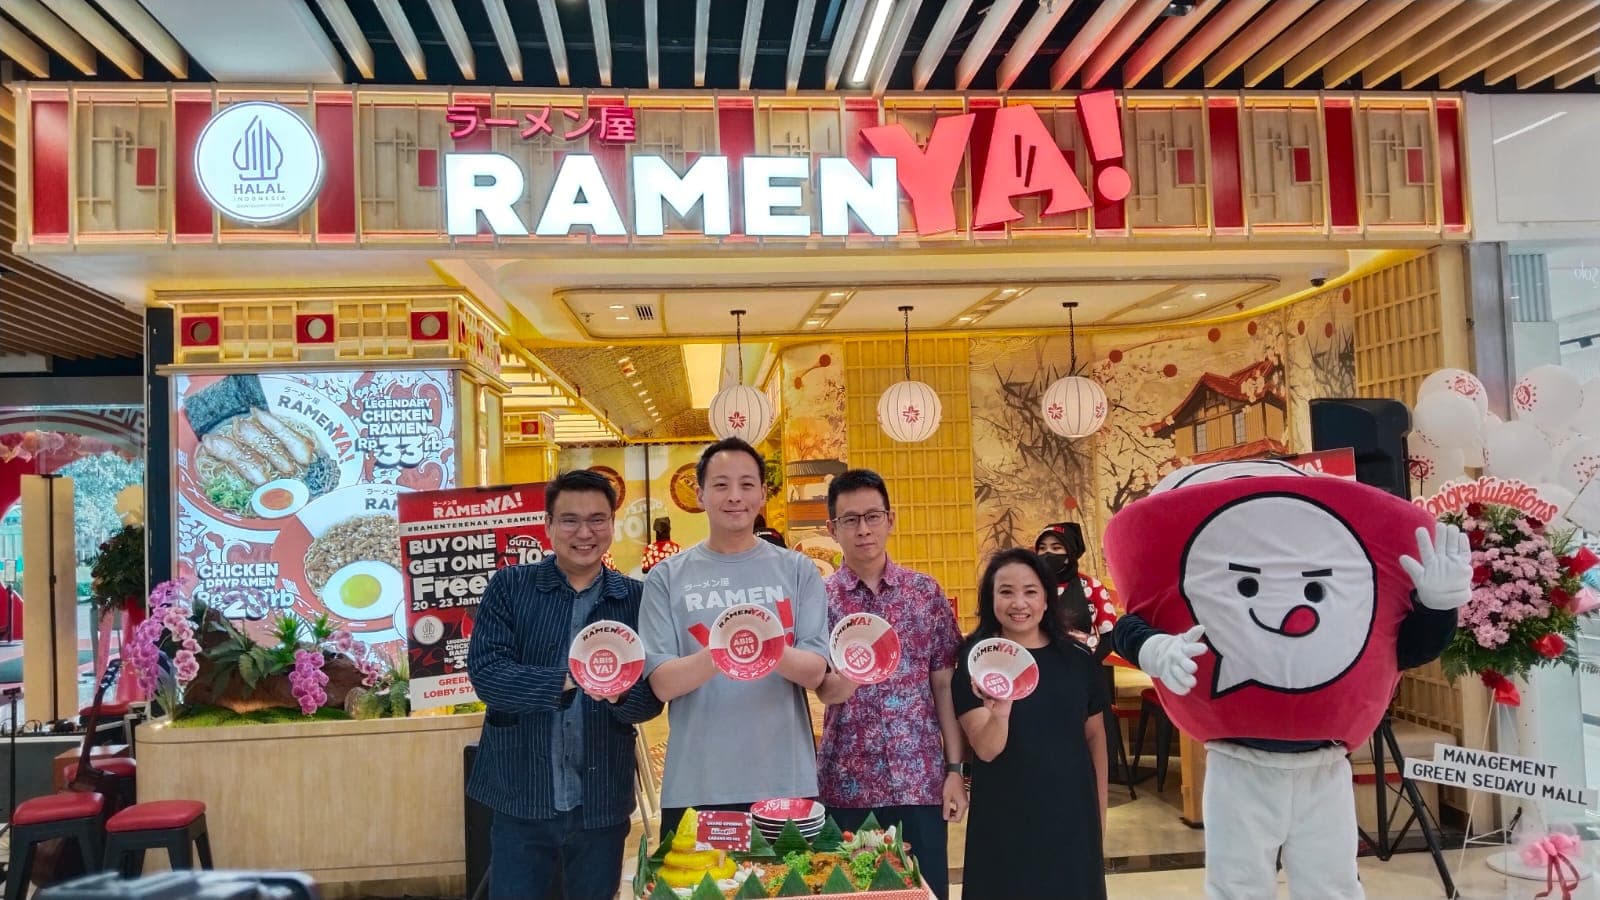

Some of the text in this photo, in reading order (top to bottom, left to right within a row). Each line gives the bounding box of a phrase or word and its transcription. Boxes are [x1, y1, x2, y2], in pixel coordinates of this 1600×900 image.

[446, 106, 637, 143] ラーメン屋
[233, 183, 285, 194] HALAL
[365, 399, 431, 409] LEGENDARY
[362, 408, 433, 423] CHICKEN
[369, 422, 428, 437] RAMEN
[366, 488, 398, 496] ラーメン
[507, 515, 545, 523] RAMENY
[408, 533, 496, 555] BUY ONE
[509, 539, 541, 548] OUTLET
[199, 563, 279, 578] CHICKEN
[408, 553, 496, 575] GET ONE
[684, 578, 730, 591] ラーメン屋
[413, 600, 429, 611] 20
[440, 598, 453, 608] 23
[685, 586, 784, 612] RAMEN
[734, 636, 754, 646] ABIS
[735, 645, 755, 655] YA!
[595, 664, 613, 674] YA!
[424, 690, 456, 699] LOBBY
[1443, 748, 1557, 779] MANAGEMENT
[1412, 763, 1588, 805] GREEN SEDAYU MALL
